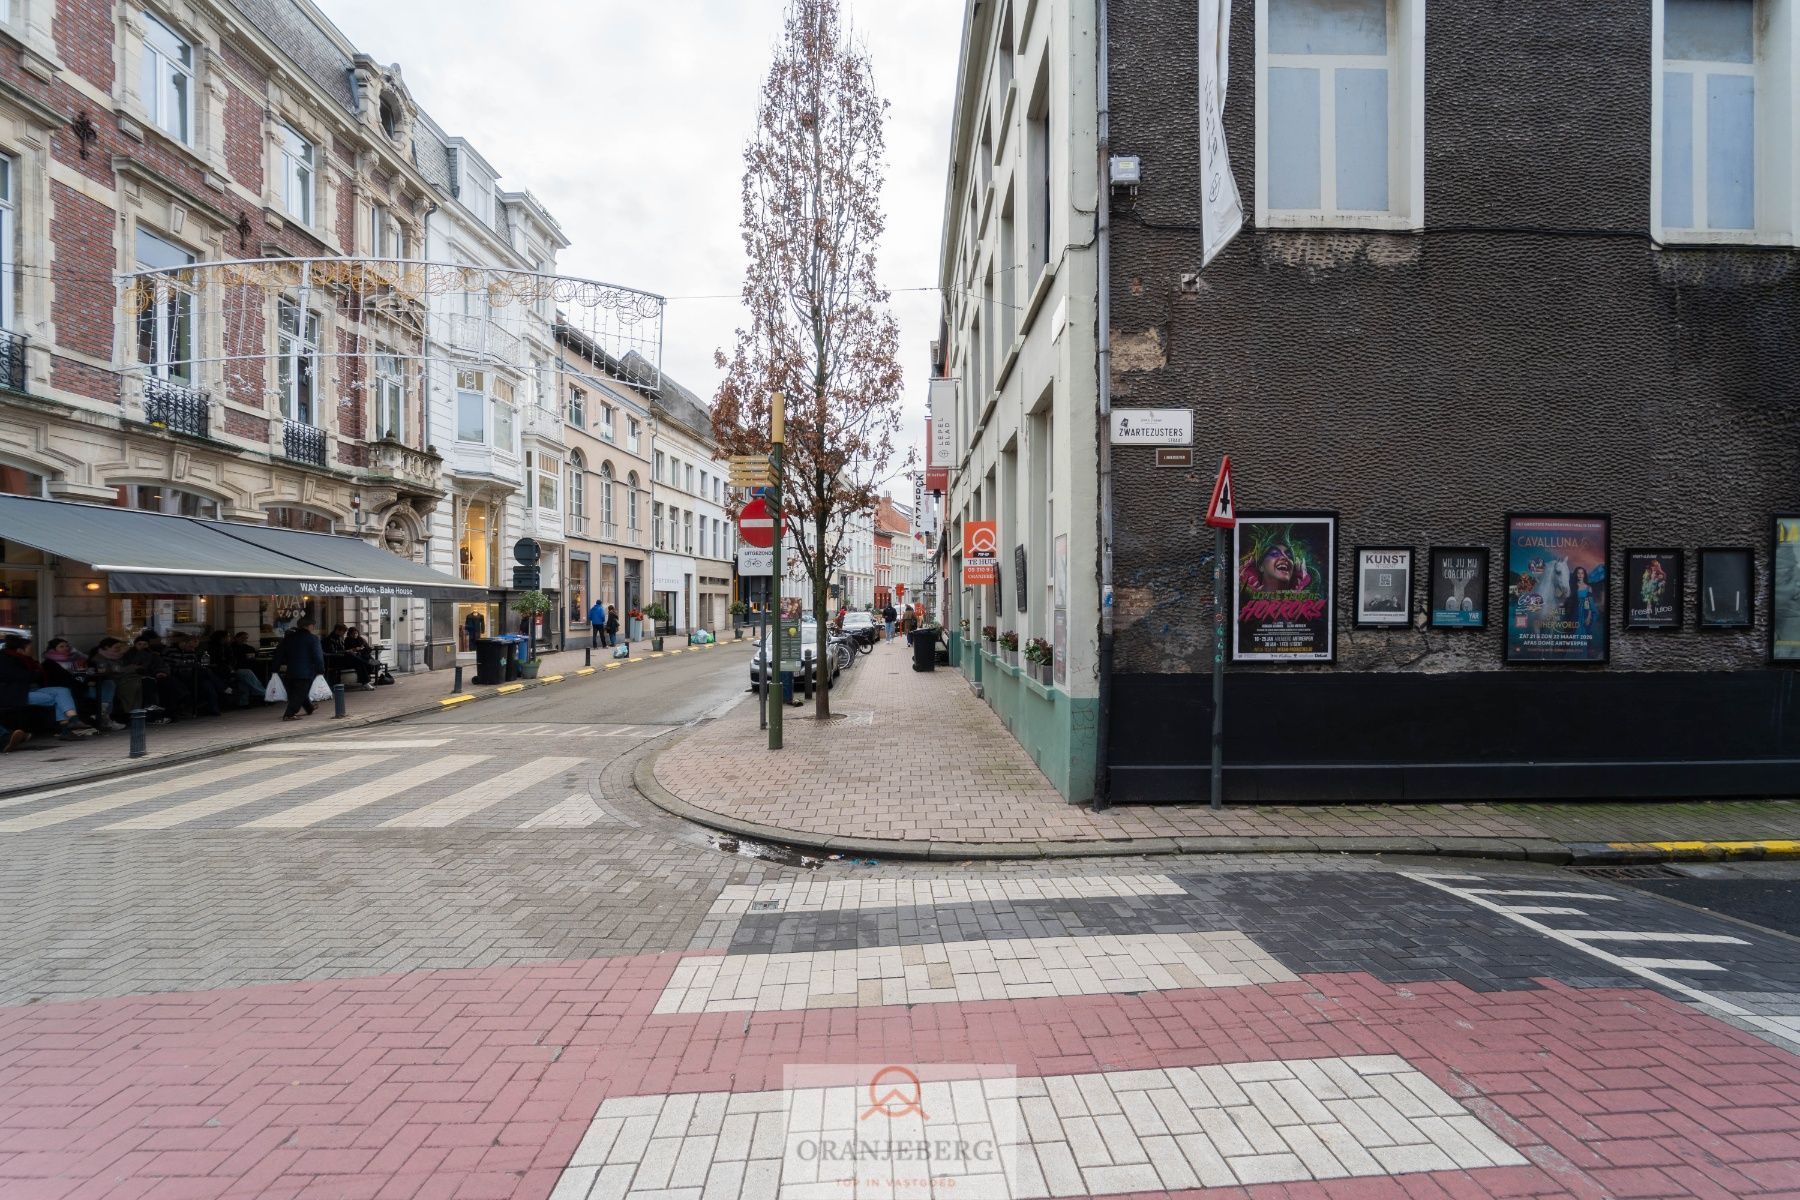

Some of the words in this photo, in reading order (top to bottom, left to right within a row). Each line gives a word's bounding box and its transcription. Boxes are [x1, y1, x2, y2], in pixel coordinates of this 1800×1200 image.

[1119, 427, 1184, 438] ZWARTEZUSTERS
[1517, 535, 1578, 549] CAVALLUNA
[1365, 554, 1407, 564] KUNST
[1442, 557, 1453, 568] WIL
[299, 582, 318, 593] WAY
[319, 583, 353, 595] Specialty
[354, 584, 376, 594] Coffee
[380, 586, 395, 595] Bake
[395, 586, 413, 596] House
[275, 594, 307, 609] WAY
[1239, 599, 1327, 621] HORRORS
[1631, 607, 1653, 616] fresh
[1654, 605, 1673, 616] juice
